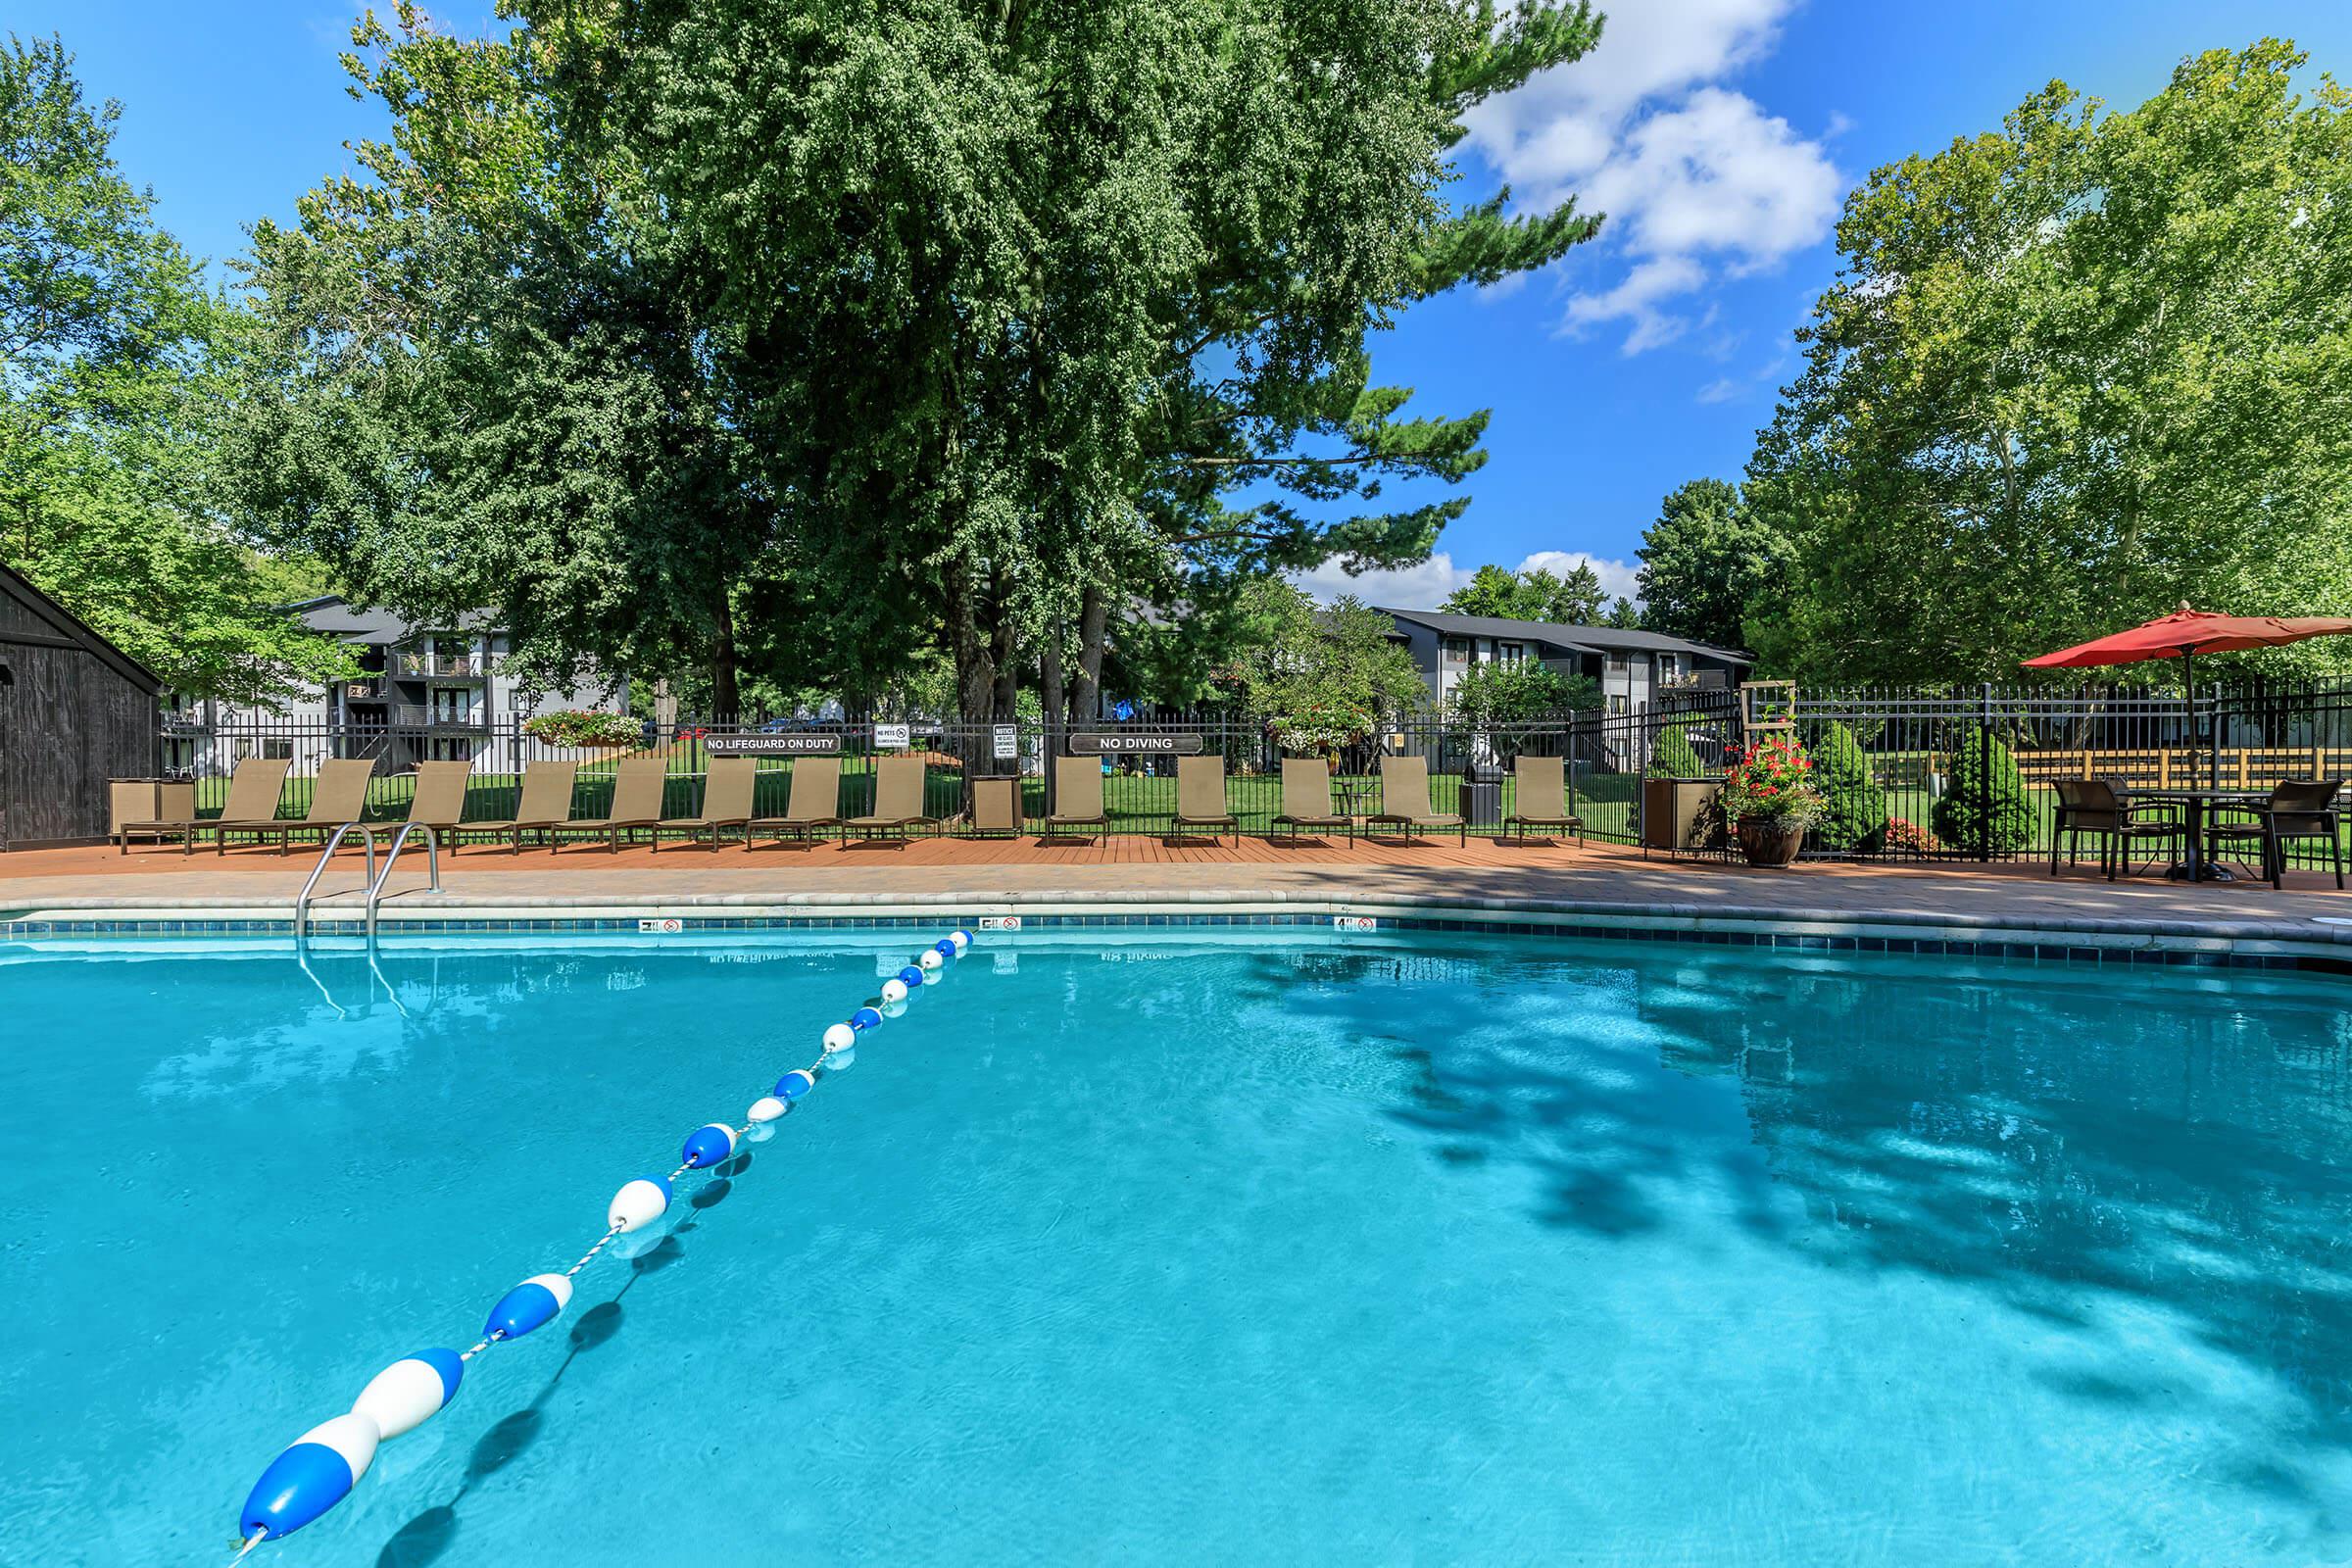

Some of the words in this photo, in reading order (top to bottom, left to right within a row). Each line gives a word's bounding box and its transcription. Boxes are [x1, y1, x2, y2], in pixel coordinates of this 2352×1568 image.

[708, 740, 723, 749] NO
[725, 739, 786, 750] LIFEGUARD
[787, 739, 804, 749] ON
[806, 739, 834, 749] DUTY
[1100, 738, 1121, 749] NO
[1125, 738, 1173, 749] DIVING
